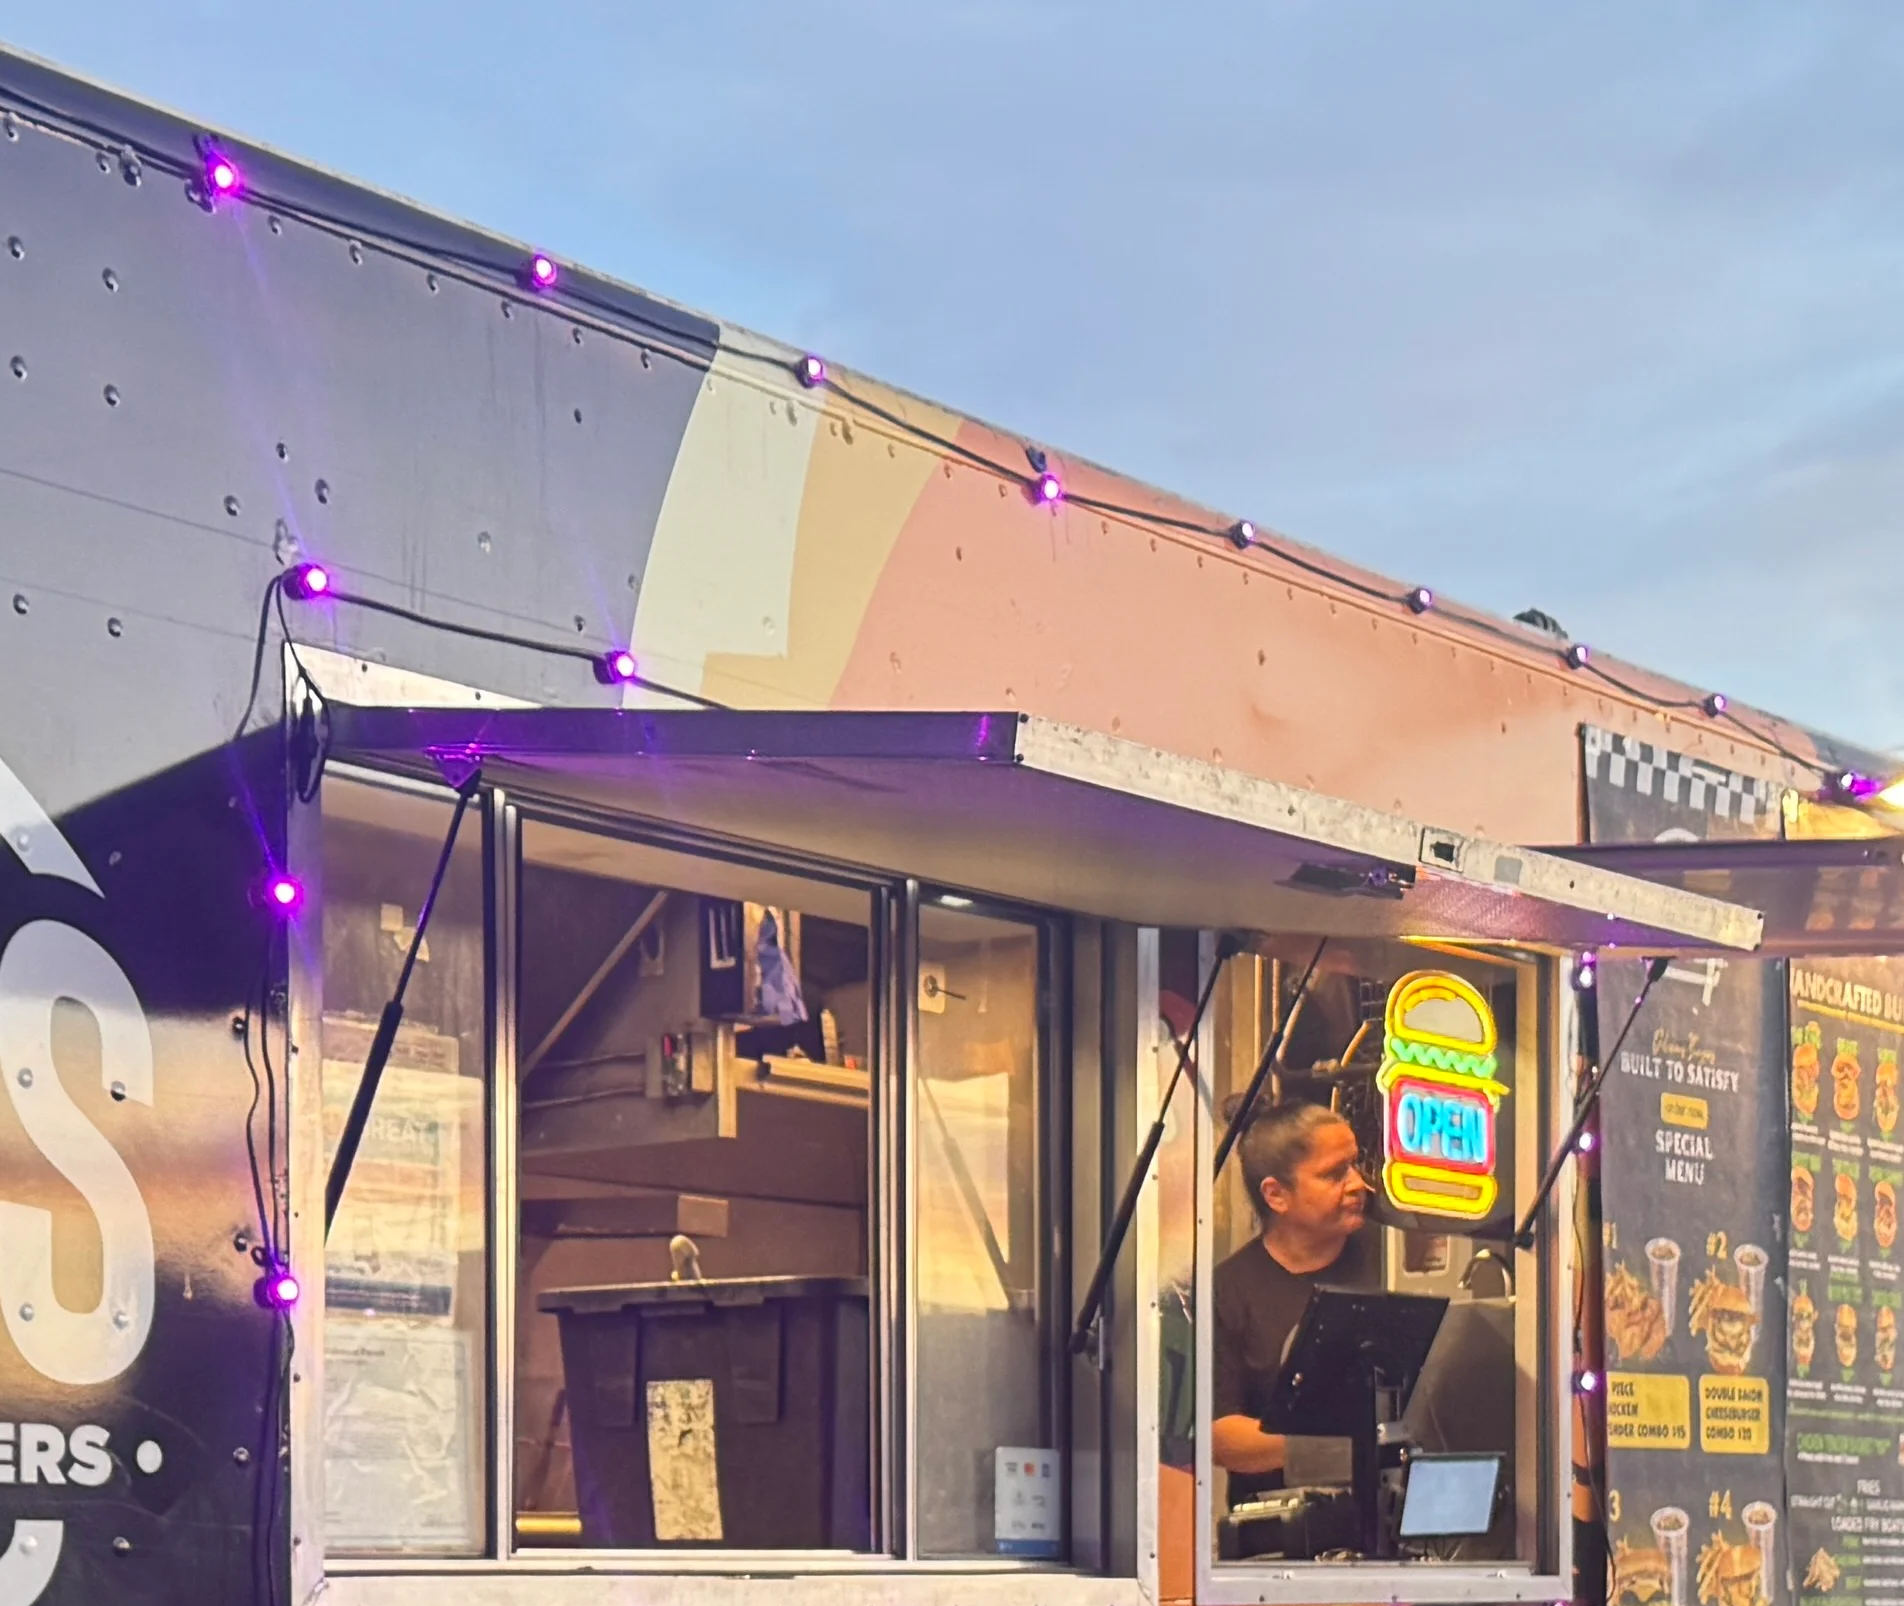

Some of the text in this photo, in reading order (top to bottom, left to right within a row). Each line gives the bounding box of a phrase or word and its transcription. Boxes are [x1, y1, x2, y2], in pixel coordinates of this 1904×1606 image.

[1620, 1052, 1739, 1093] BUILT TO SATISFY
[1398, 1093, 1487, 1163] OPEN
[1655, 1129, 1714, 1160] SPECIAL
[1665, 1159, 1704, 1185] MENU
[1706, 1231, 1727, 1259] #2
[1637, 1424, 1669, 1438] COMBO
[1708, 1489, 1732, 1520] #4
